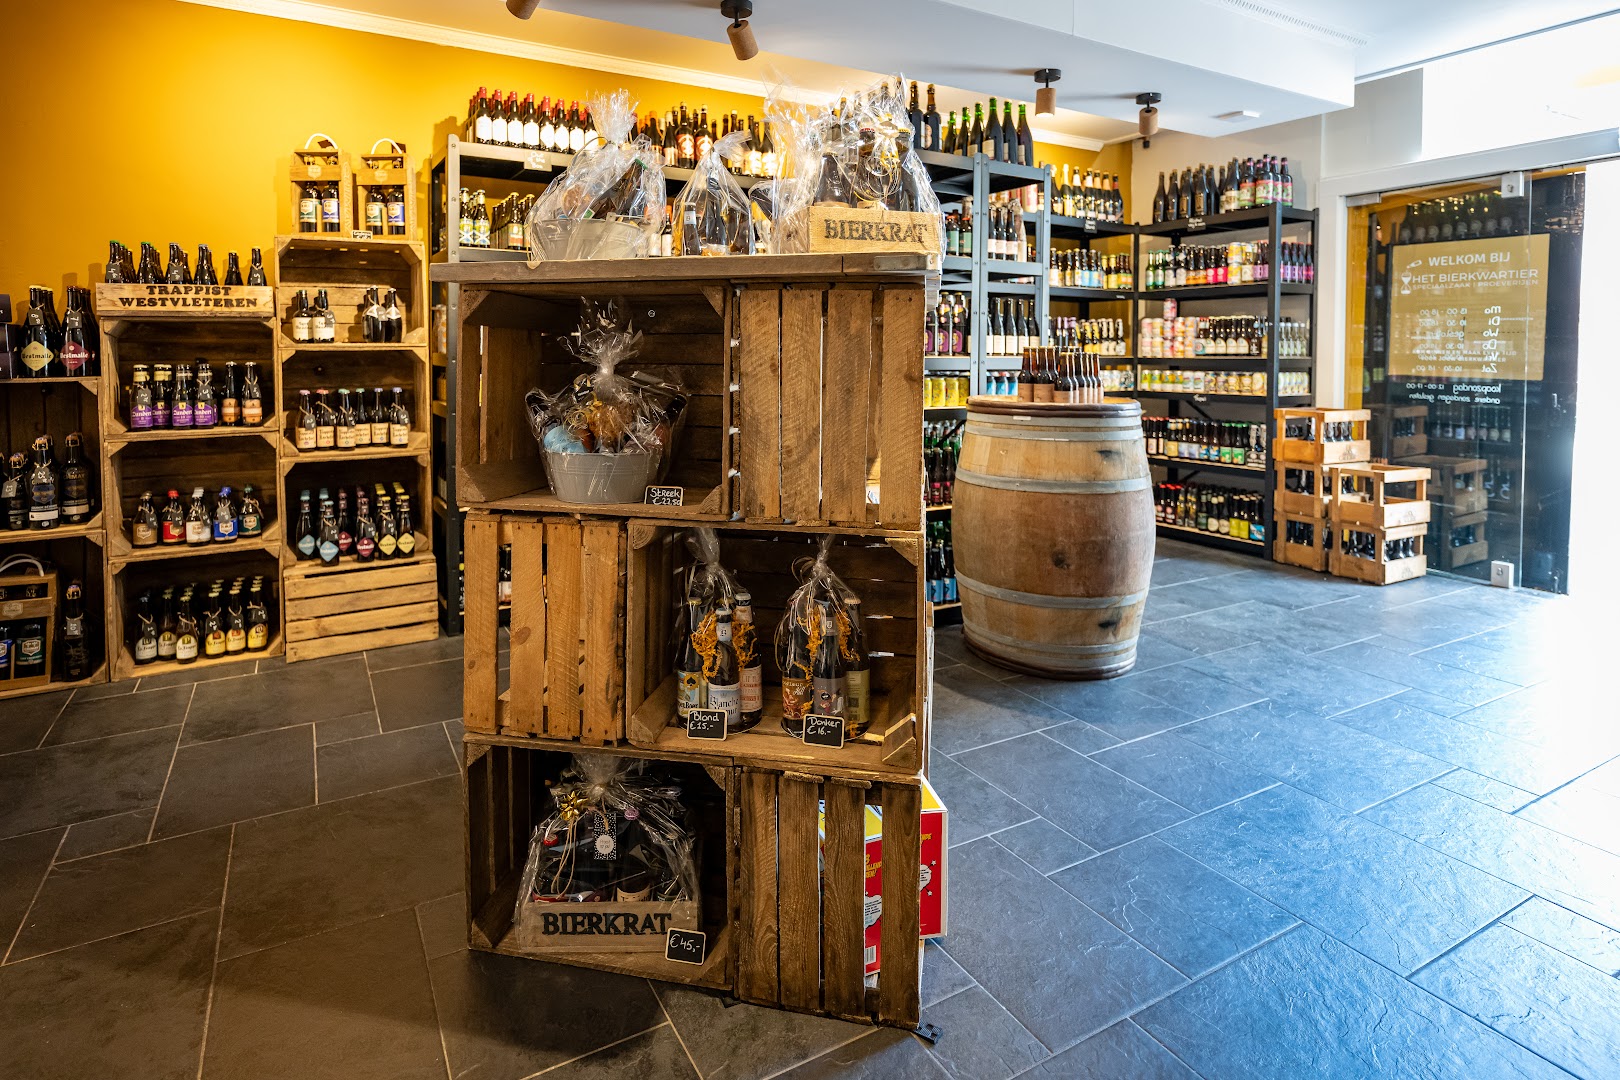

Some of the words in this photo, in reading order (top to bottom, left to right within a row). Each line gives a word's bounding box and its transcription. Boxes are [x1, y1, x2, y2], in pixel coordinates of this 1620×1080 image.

[824, 219, 928, 243] BIERKRAT
[1428, 253, 1486, 267] WELKOM
[1490, 251, 1511, 263] BIJ
[1412, 274, 1435, 283] HET
[1439, 269, 1539, 282] BIERKWARTIER
[146, 286, 232, 296] TRAPPIST
[1413, 283, 1471, 291] SPECIAALZAAK
[1478, 279, 1539, 287] PROEVERIJEN
[119, 298, 258, 308] WESTVLETEREN
[710, 695, 739, 710] Blanche
[690, 710, 720, 722] Blond
[807, 716, 841, 728] Donker
[541, 912, 672, 936] BIERKRAT
